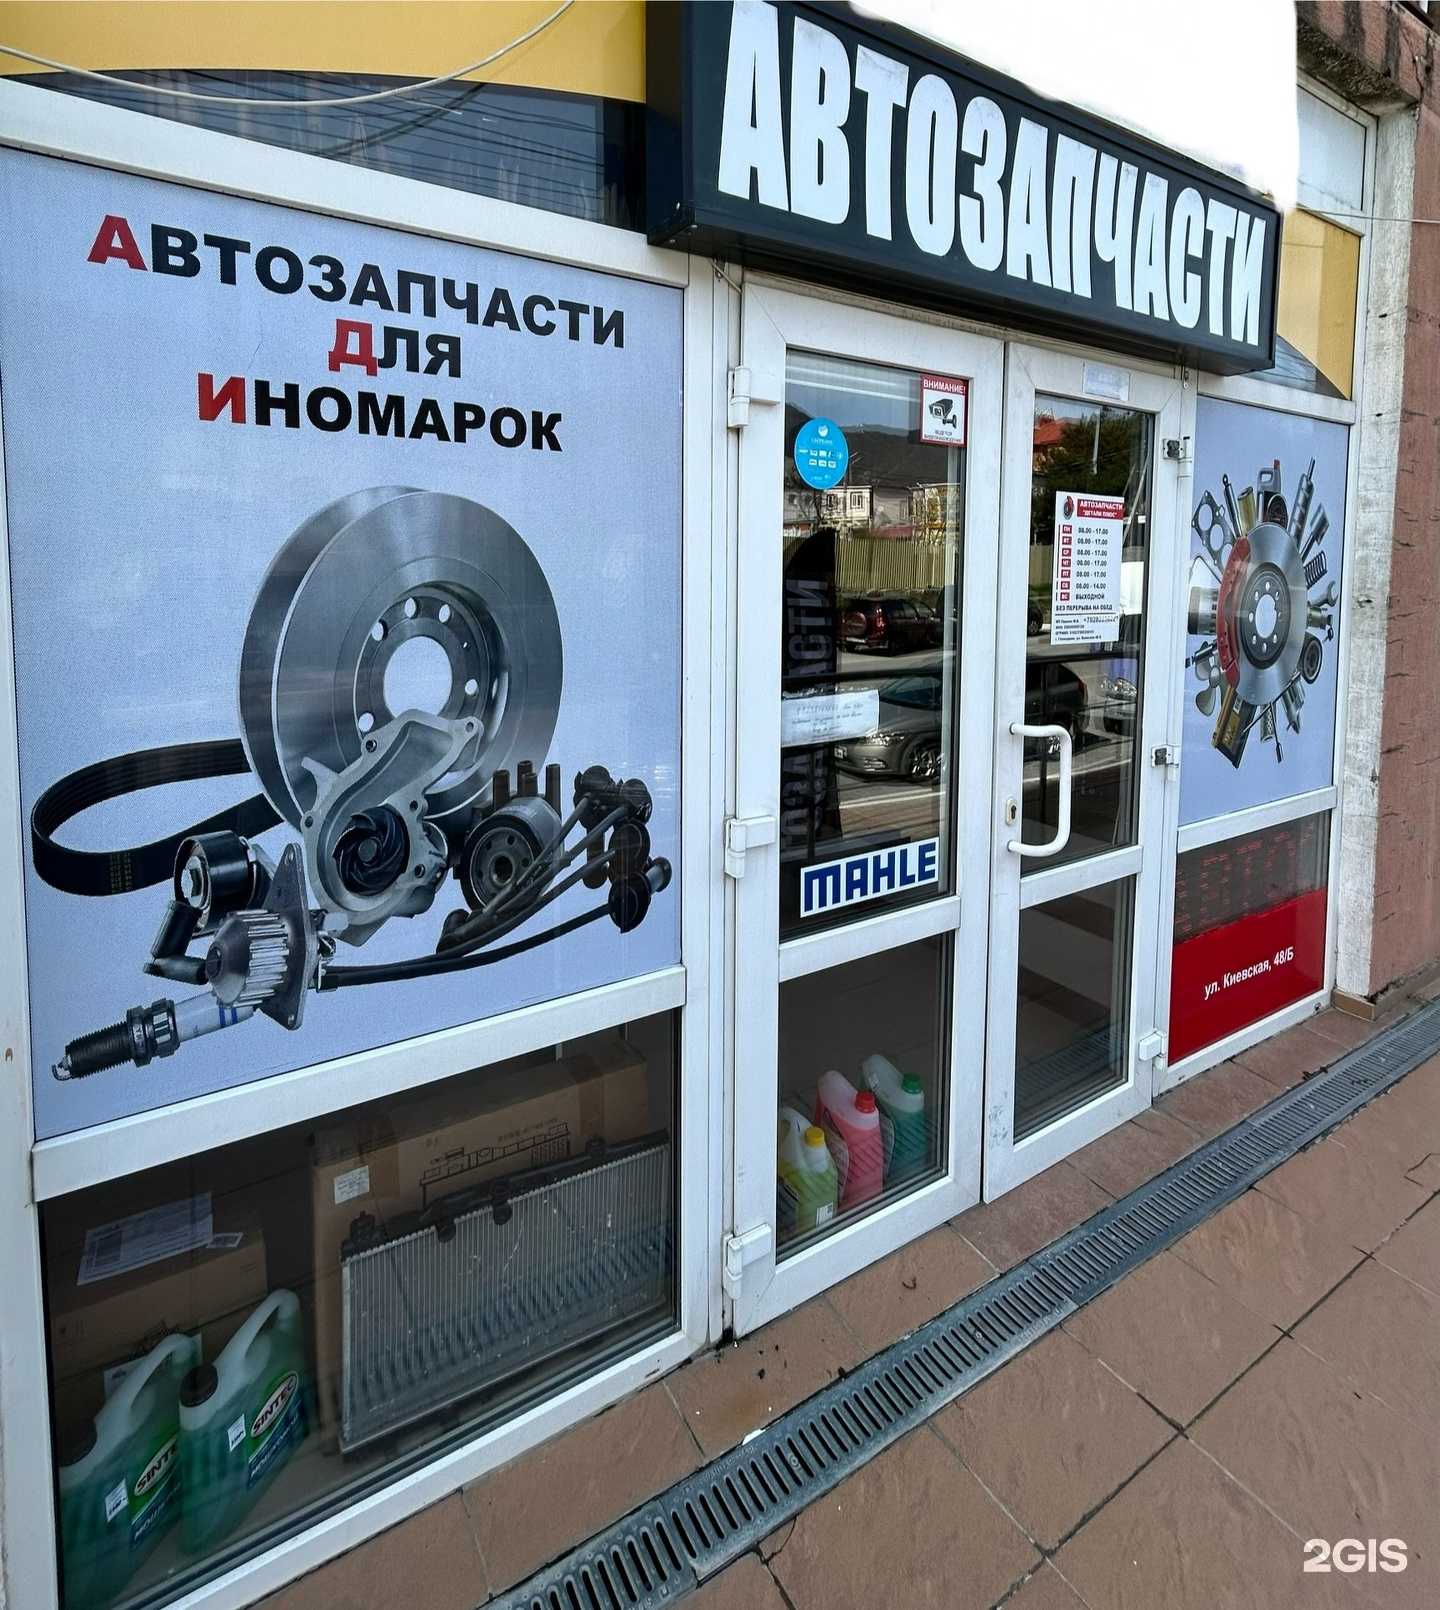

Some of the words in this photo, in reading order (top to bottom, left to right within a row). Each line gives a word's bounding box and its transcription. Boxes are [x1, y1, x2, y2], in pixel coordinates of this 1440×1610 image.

[717, 0, 1267, 346] АВТОЗАПЧАСТИ
[86, 214, 625, 349] АВТОЗАПЧАСТИ
[327, 318, 462, 378] ДЛЯ
[197, 372, 563, 452] ИНОМАРОК
[923, 378, 966, 394] ВНИМАНИЕ!
[1079, 500, 1123, 511] АВТОЗАПЧАСТИ
[1075, 592, 1105, 601] ВЫХОДНОЙ
[804, 841, 936, 912] MAHLE
[1204, 981, 1221, 1001] ул.
[1223, 959, 1272, 989] Киевская,
[1273, 946, 1294, 966] 48/Б
[253, 1377, 295, 1435] SINTEC
